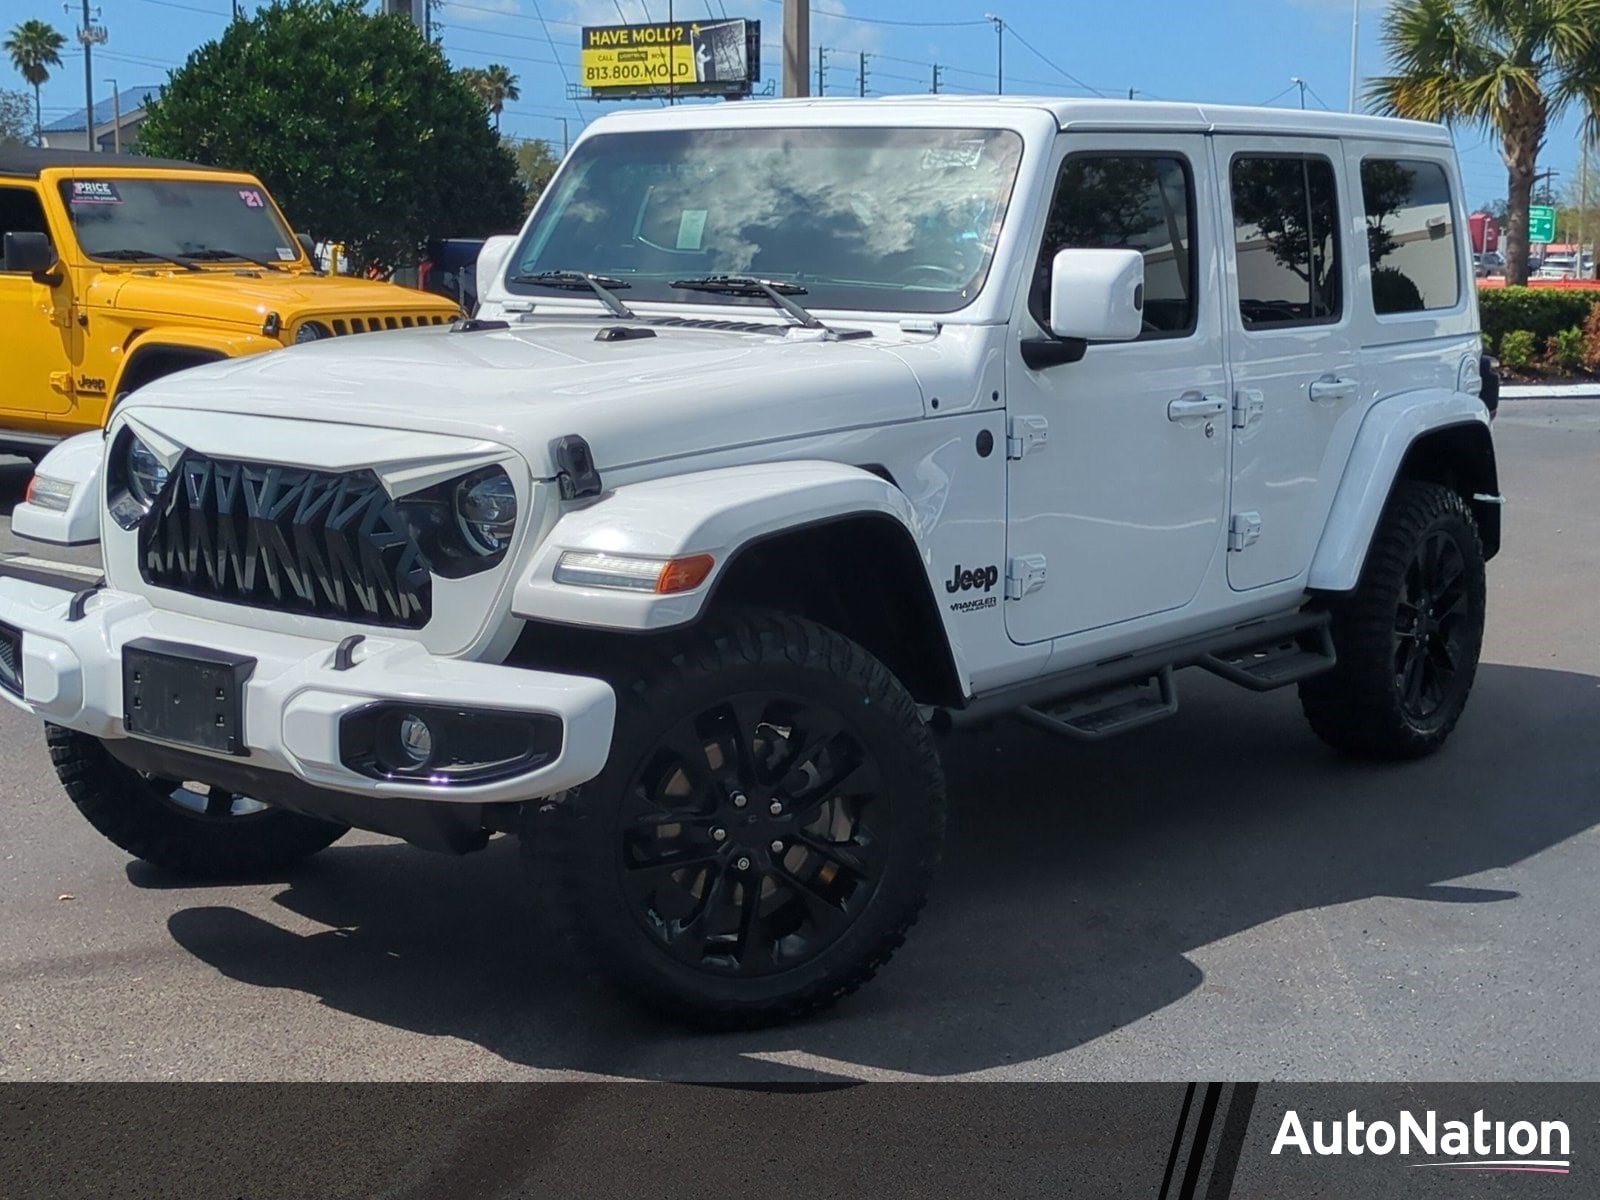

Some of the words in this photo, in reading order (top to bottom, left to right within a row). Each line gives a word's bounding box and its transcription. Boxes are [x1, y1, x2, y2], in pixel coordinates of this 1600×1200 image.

[589, 30, 629, 46] HAVE
[632, 26, 683, 43] MOLD?
[77, 374, 106, 392] Jeep
[945, 564, 998, 594] Jeep
[950, 596, 997, 611] WRANGLER
